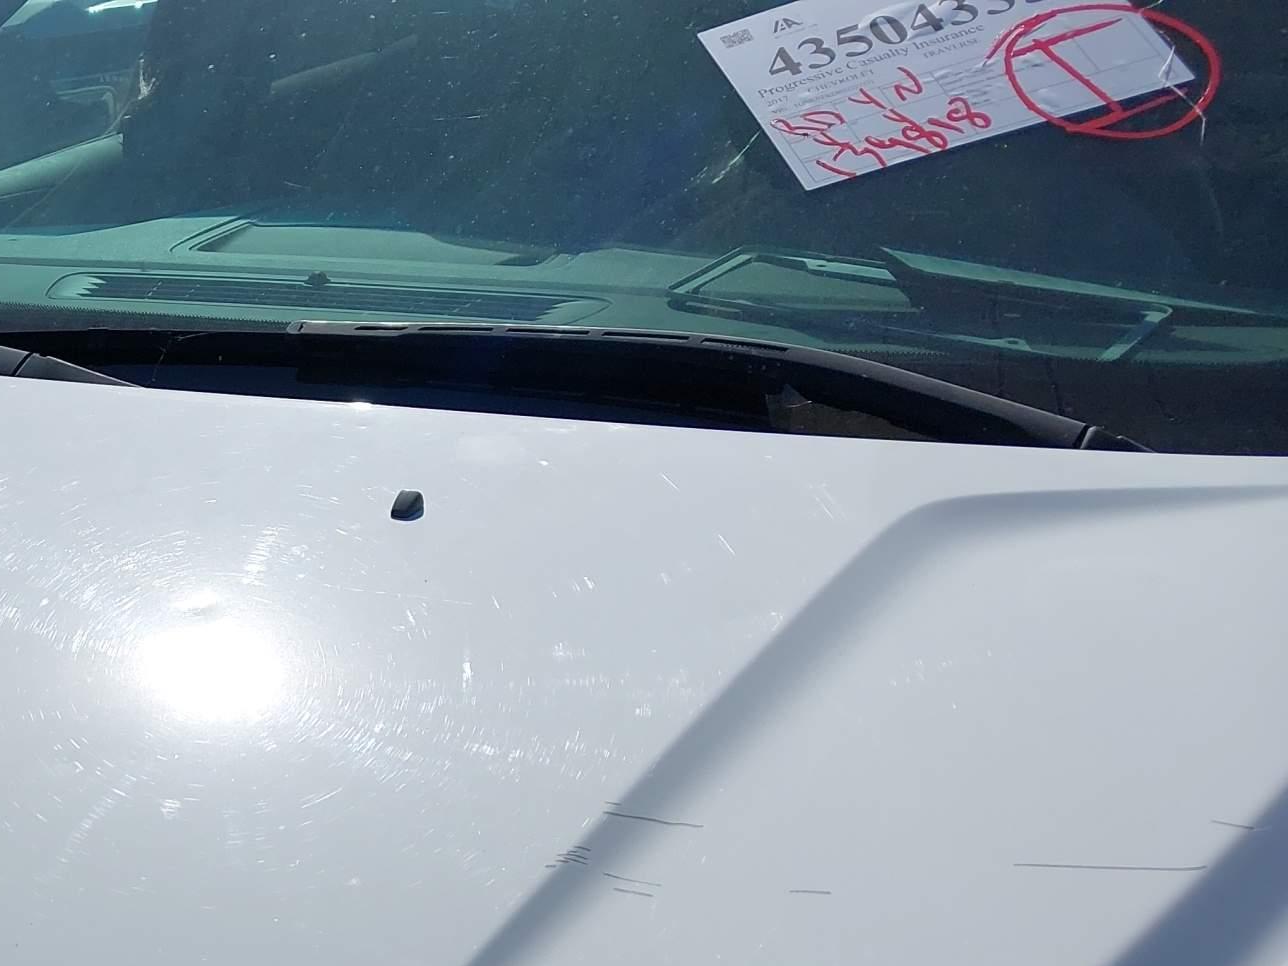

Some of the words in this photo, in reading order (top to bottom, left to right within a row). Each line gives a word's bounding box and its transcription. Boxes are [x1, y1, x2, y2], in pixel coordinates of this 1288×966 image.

[757, 65, 844, 99] Progressive
[846, 43, 910, 71] Casualty
[913, 23, 985, 51] Insurance
[767, 95, 789, 107] 2017
[807, 69, 875, 93] CHEVROLET
[923, 37, 980, 59] TRAVERSE
[768, 0, 1043, 76] 435043
